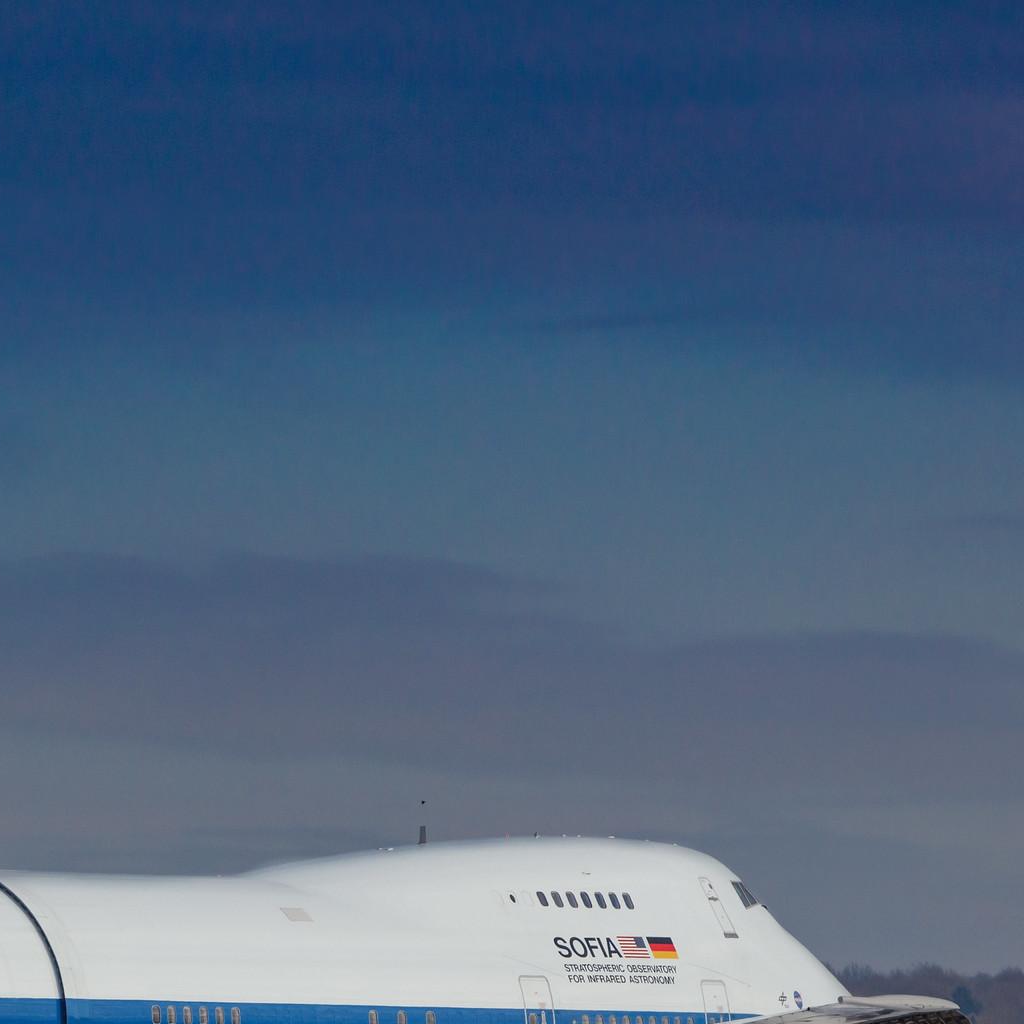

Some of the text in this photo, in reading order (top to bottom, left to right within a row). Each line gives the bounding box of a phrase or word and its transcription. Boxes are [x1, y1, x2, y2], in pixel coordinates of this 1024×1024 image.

[553, 936, 623, 958] SOFIA
[564, 963, 677, 974] STRATOSPHERIC OBSERVATORY
[568, 974, 675, 985] FOR INFRARED ASTRONOMY
